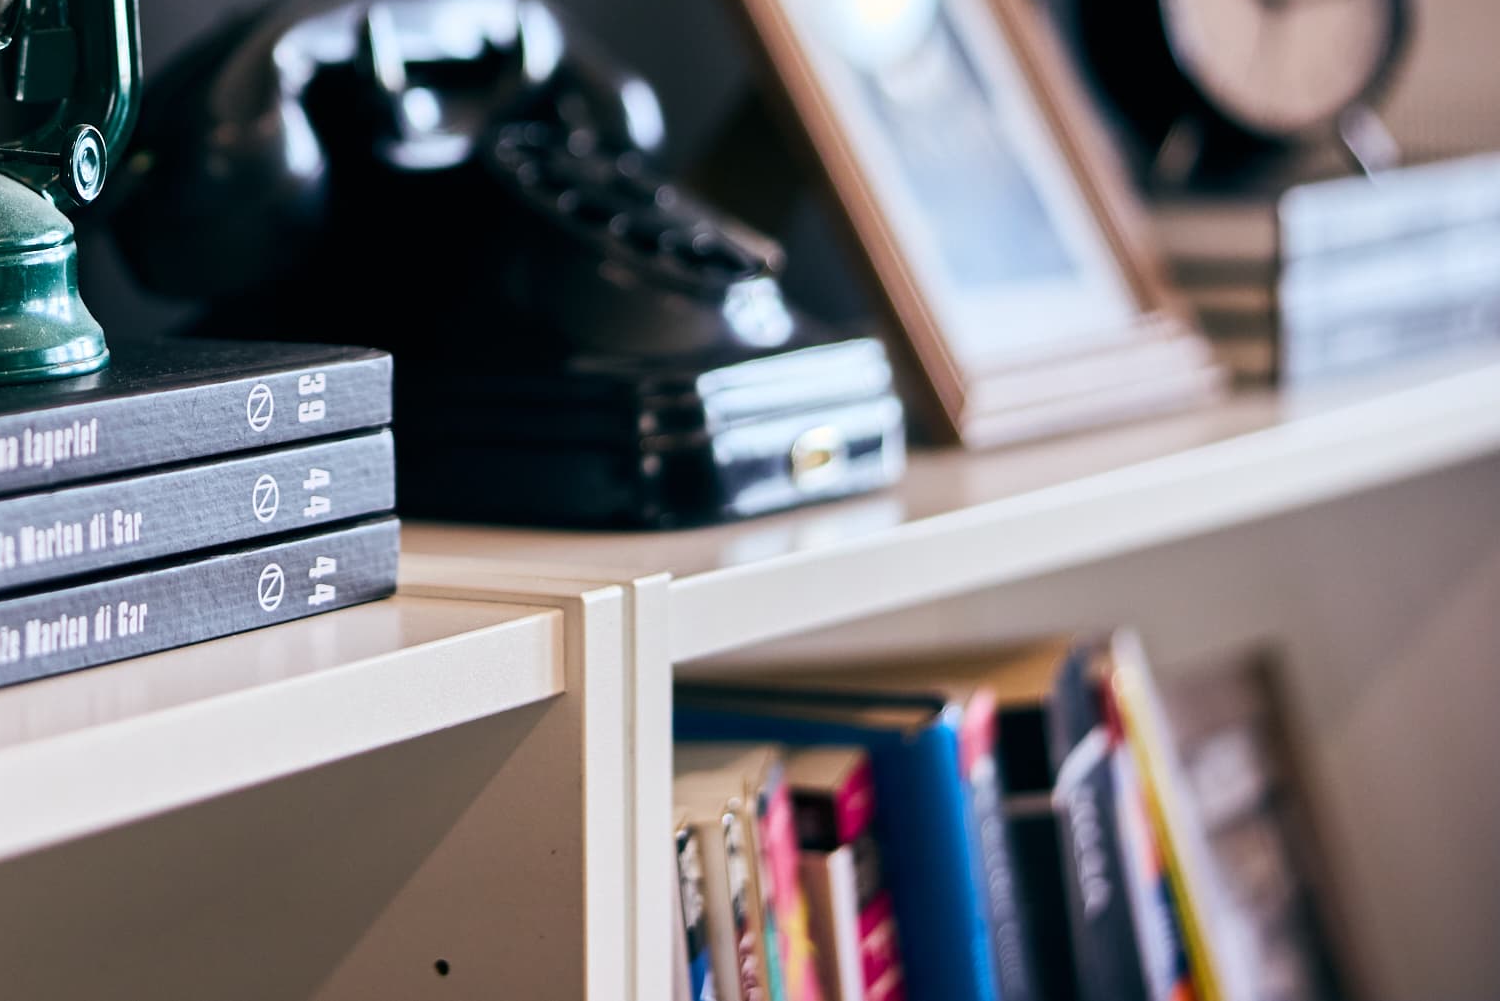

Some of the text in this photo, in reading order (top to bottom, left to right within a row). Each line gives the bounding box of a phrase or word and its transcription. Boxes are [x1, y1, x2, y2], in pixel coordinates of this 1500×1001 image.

[298, 372, 326, 423] 39
[302, 467, 331, 518] 44
[89, 511, 107, 551] di
[112, 508, 143, 547] Gar
[307, 555, 337, 606] 44
[94, 604, 112, 643] di
[116, 600, 149, 638] Gar
